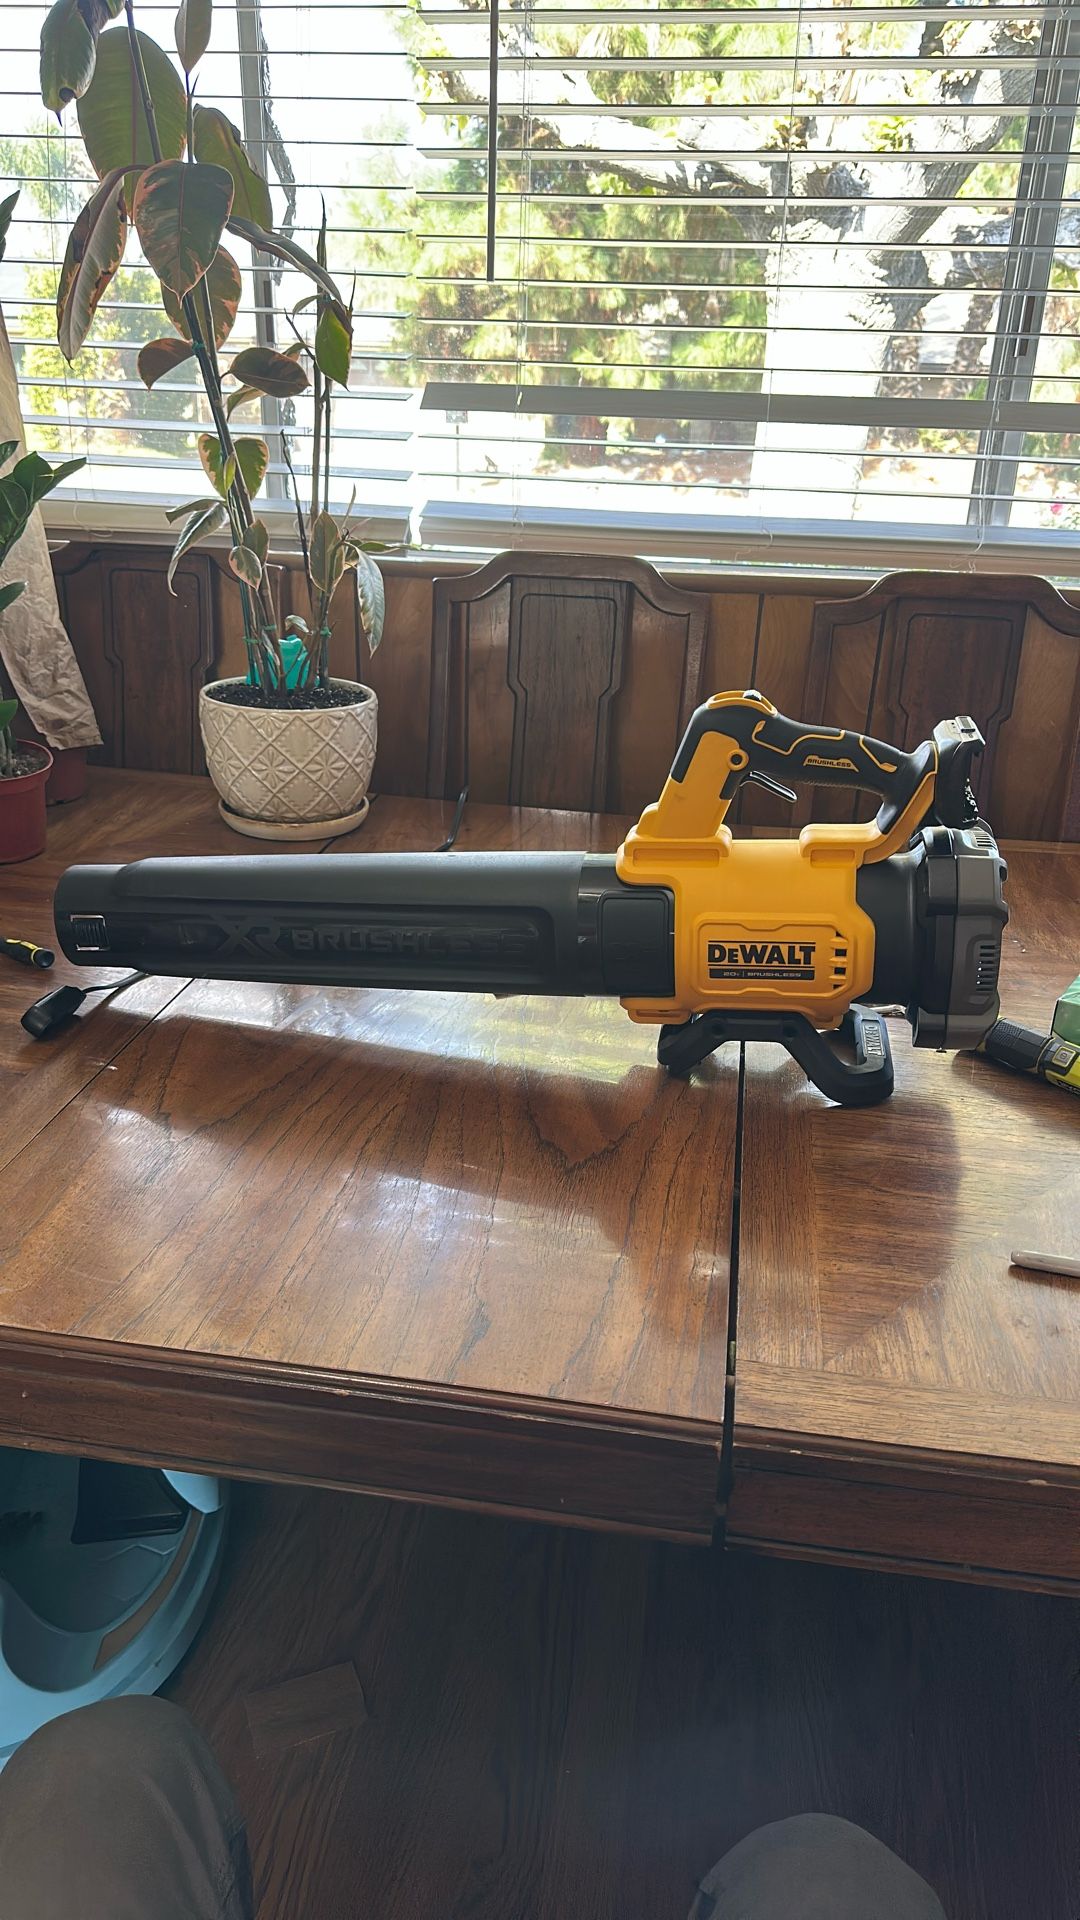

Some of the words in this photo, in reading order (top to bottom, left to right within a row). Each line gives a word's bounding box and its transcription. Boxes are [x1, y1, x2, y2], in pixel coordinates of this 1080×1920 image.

[807, 758, 851, 768] BRUSHLESS
[211, 914, 290, 957] XR
[708, 944, 815, 965] DEWALT
[864, 1024, 882, 1056] DEWALT
